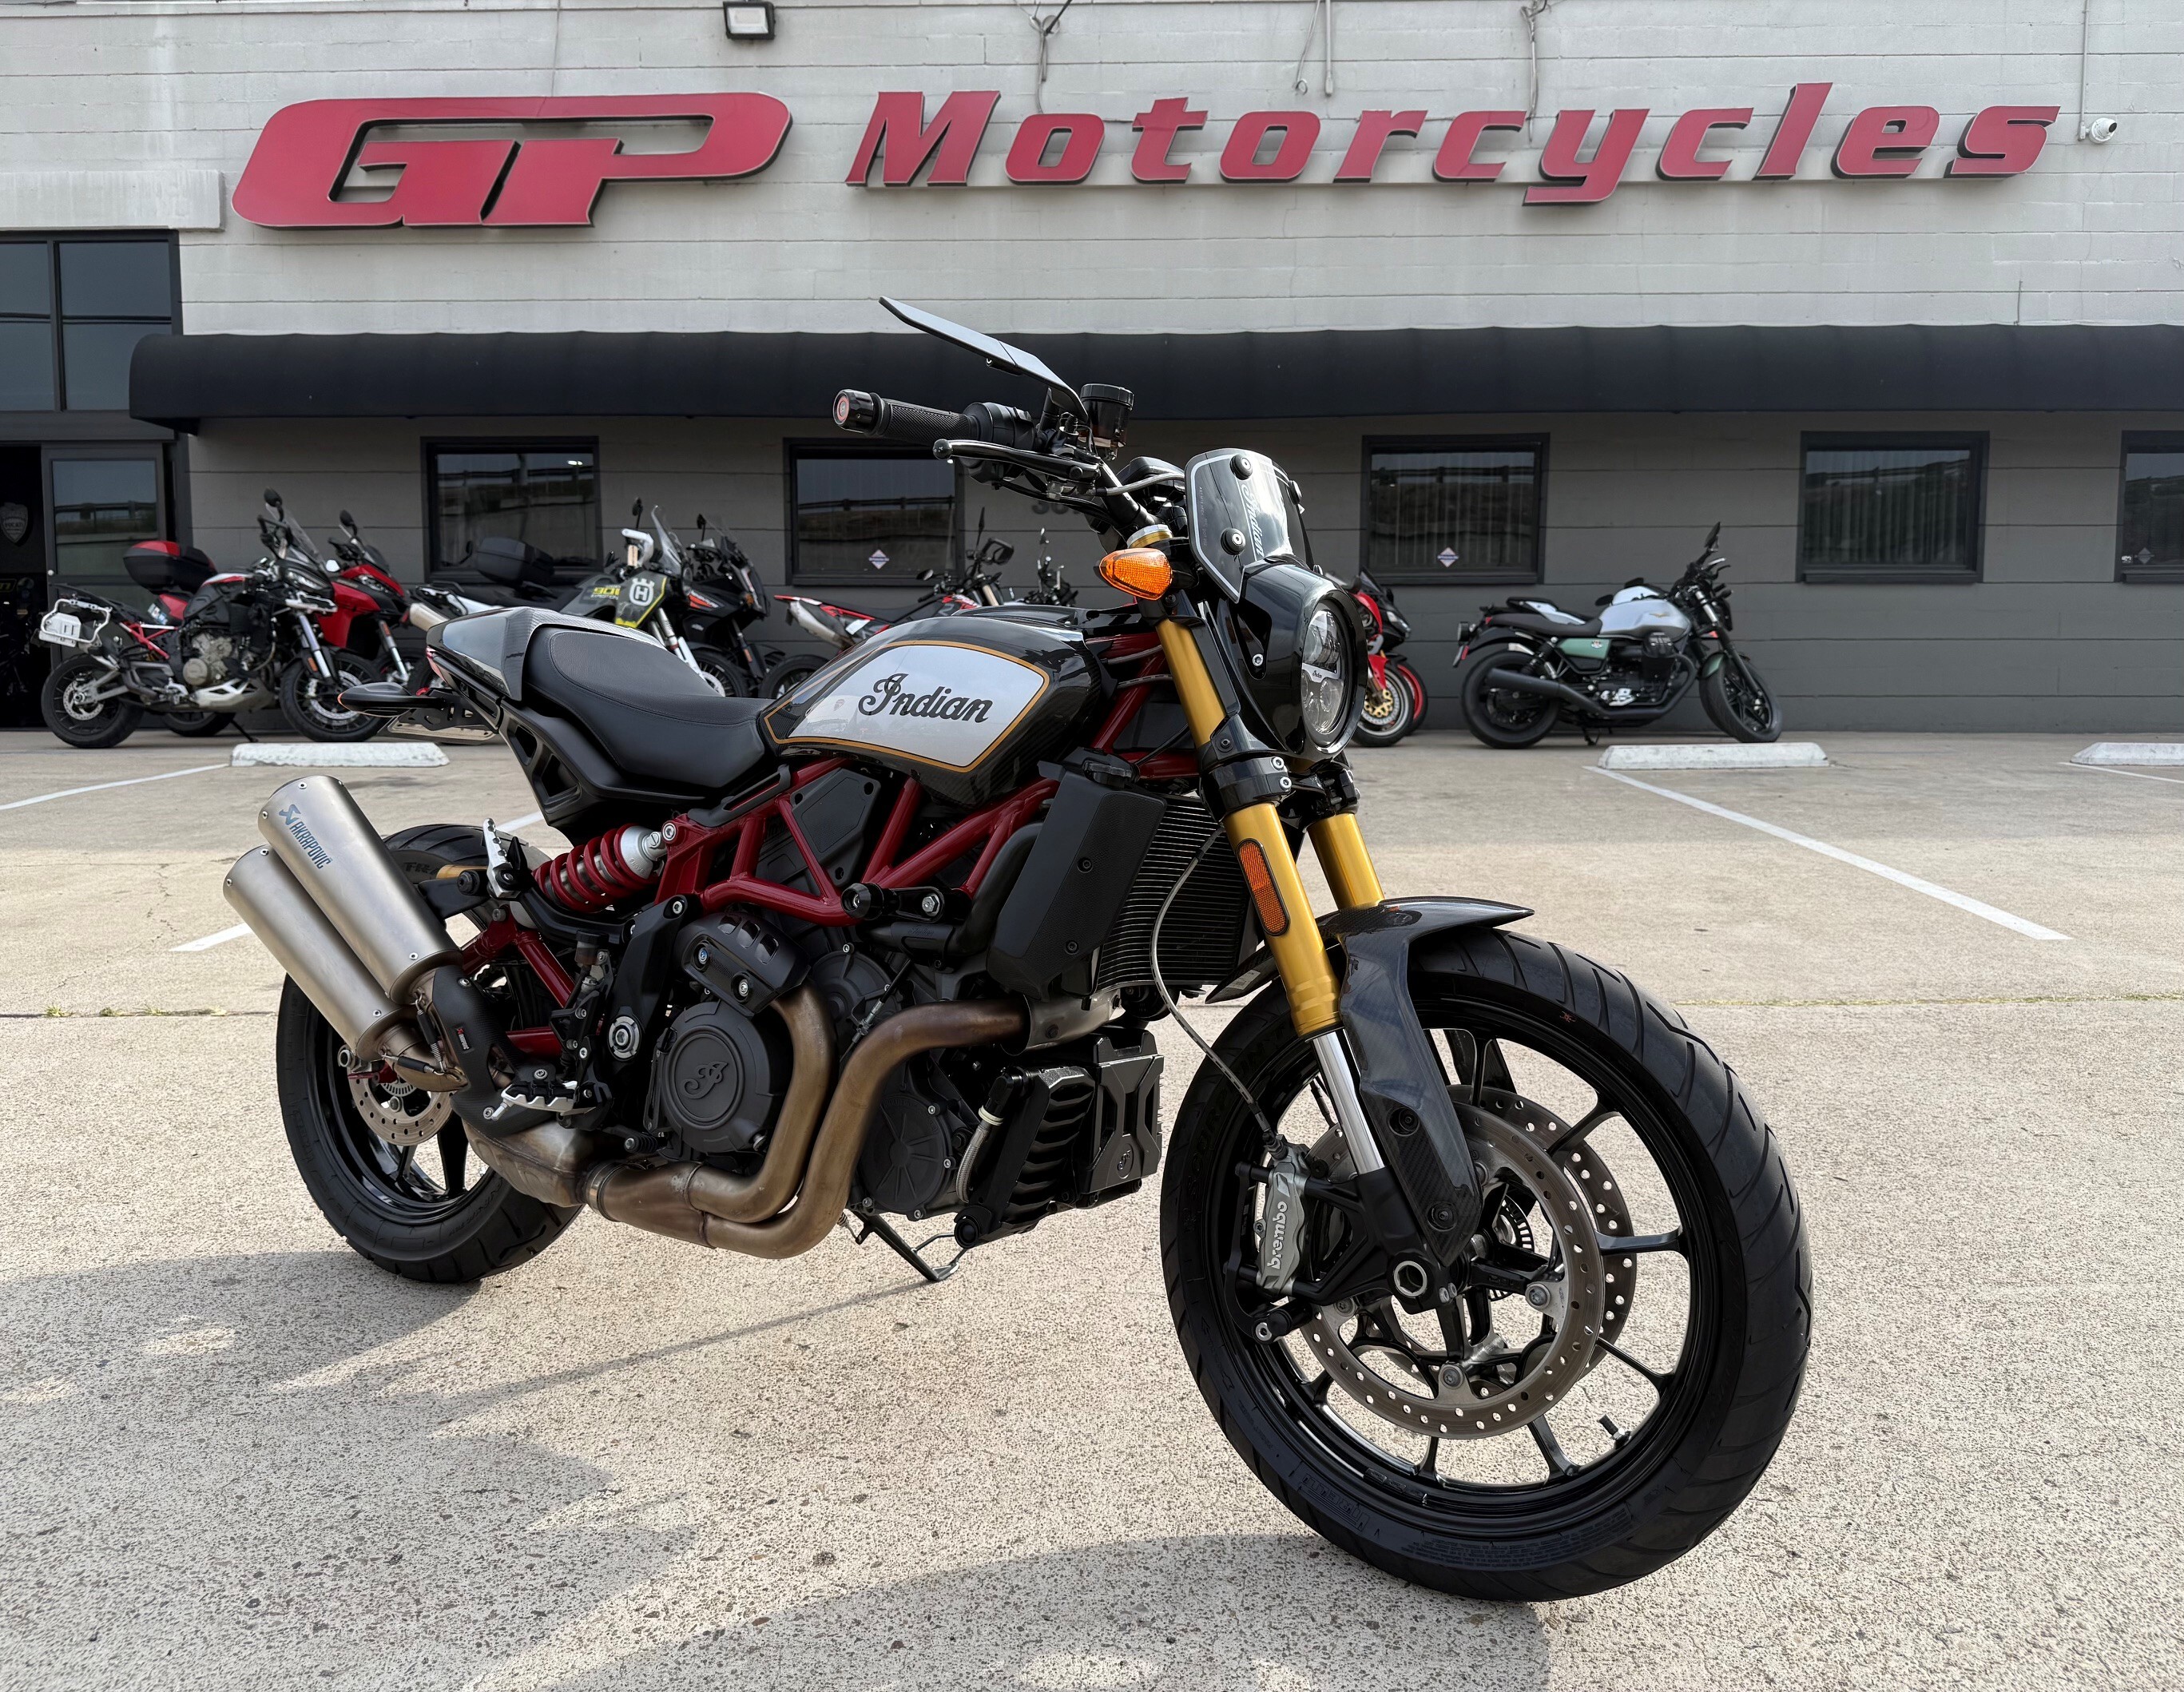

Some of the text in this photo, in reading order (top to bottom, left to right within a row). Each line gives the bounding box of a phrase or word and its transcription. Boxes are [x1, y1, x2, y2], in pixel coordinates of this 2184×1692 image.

[232, 82, 2061, 229] GP Motorcycles
[1241, 484, 1265, 557] Indian
[858, 673, 994, 724] Indian
[1266, 1201, 1288, 1269] brembo
